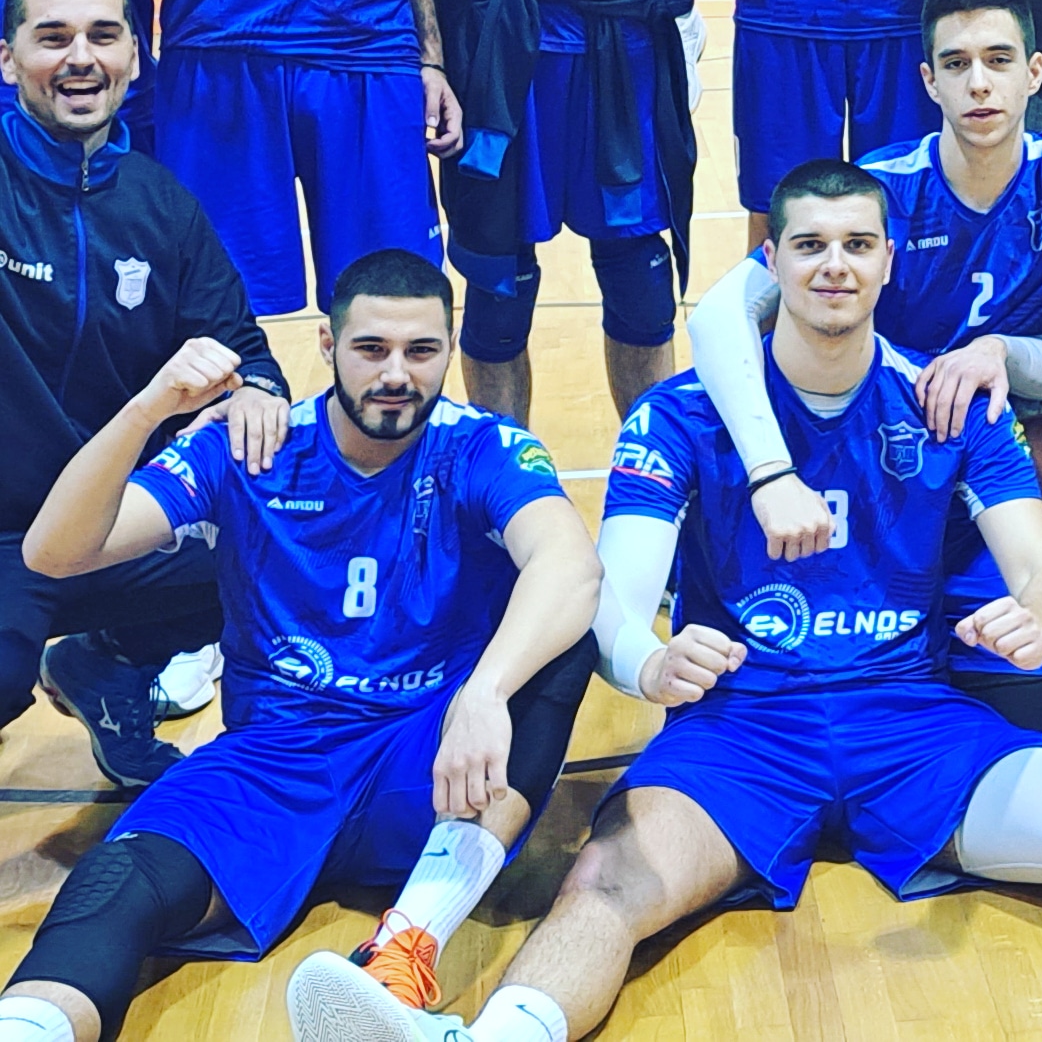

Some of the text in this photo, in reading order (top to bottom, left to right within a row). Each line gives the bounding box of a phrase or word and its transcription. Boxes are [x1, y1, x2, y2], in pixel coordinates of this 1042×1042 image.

[966, 272, 994, 327] 2
[815, 489, 849, 549] 3
[342, 556, 378, 618] 8
[813, 610, 921, 636] ELNOS
